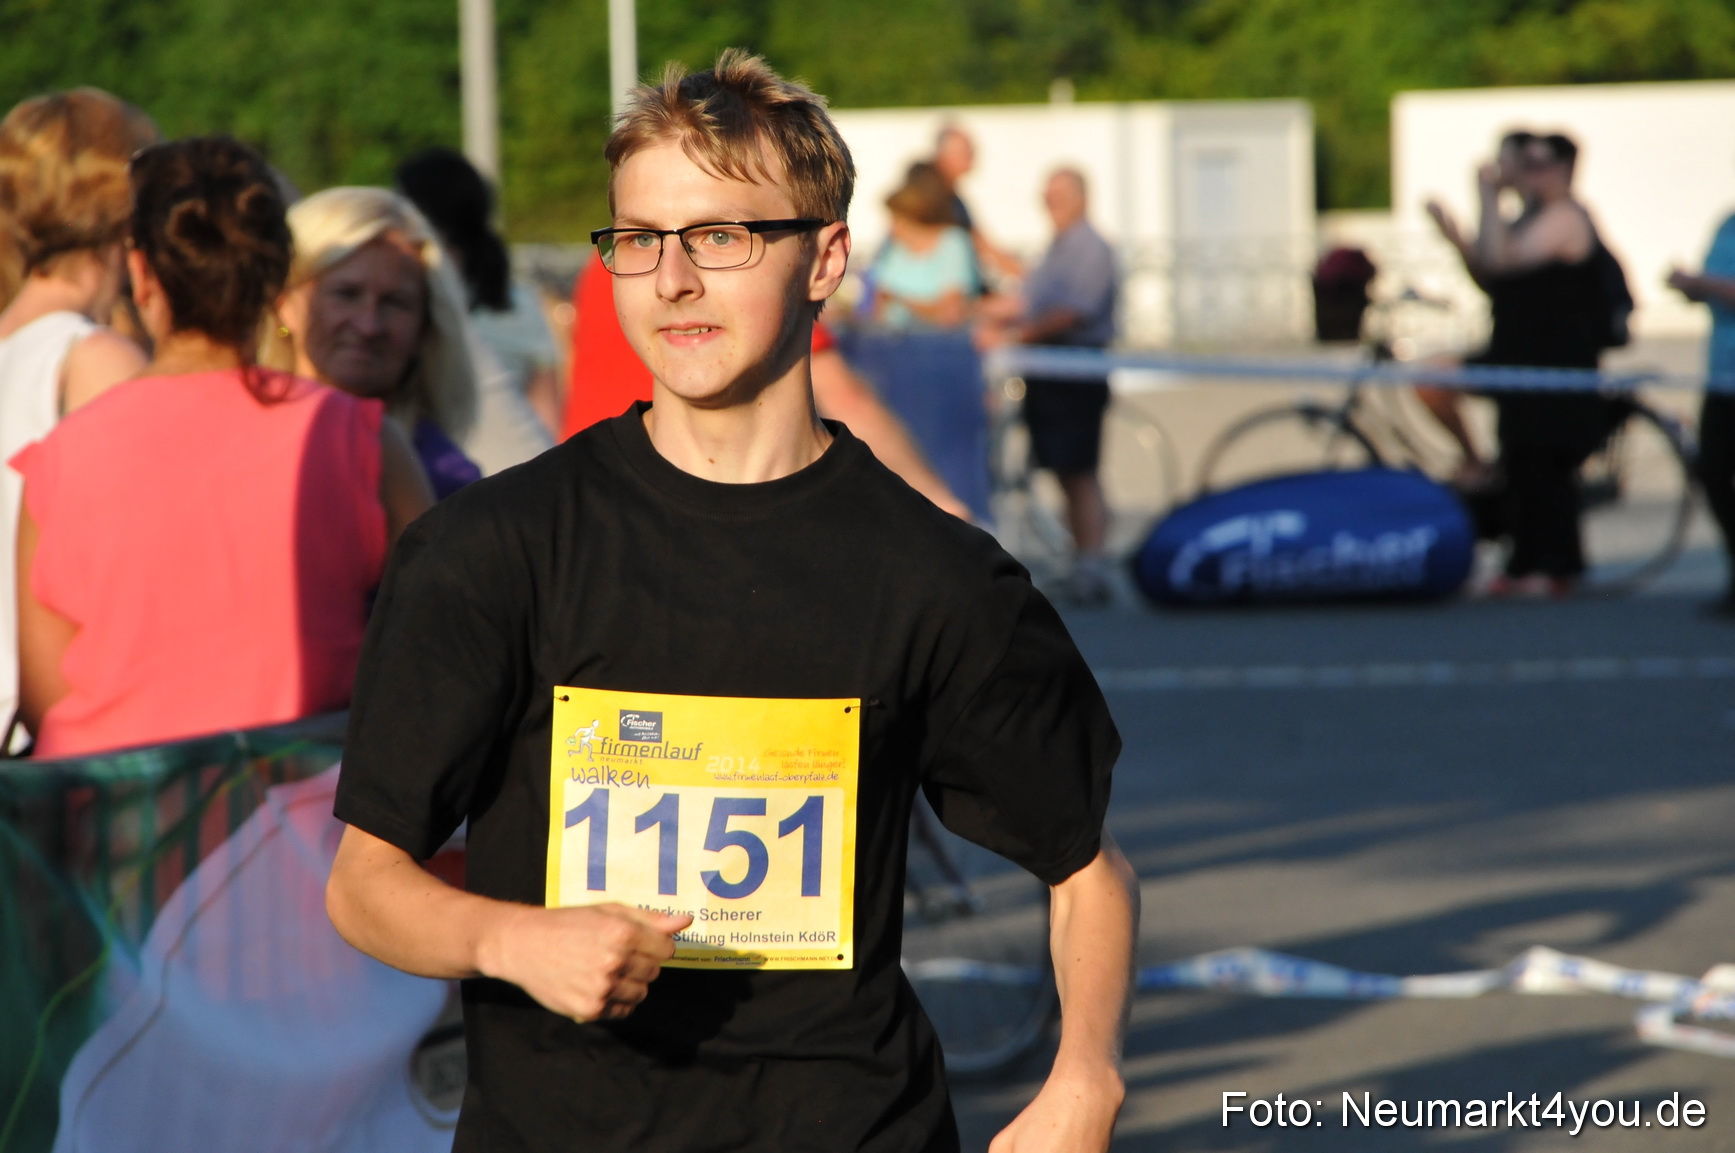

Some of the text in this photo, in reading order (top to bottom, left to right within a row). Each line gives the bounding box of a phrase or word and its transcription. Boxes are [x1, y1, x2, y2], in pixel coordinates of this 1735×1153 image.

[626, 718, 657, 728] Fischer
[600, 736, 704, 761] firmenlauf
[600, 756, 643, 765] neumarkt
[705, 755, 760, 773] 2014
[571, 765, 650, 789] walken
[565, 787, 825, 900] 1151
[699, 908, 762, 921] Scherer
[672, 930, 836, 946] Stiftung Holnstein KdöR
